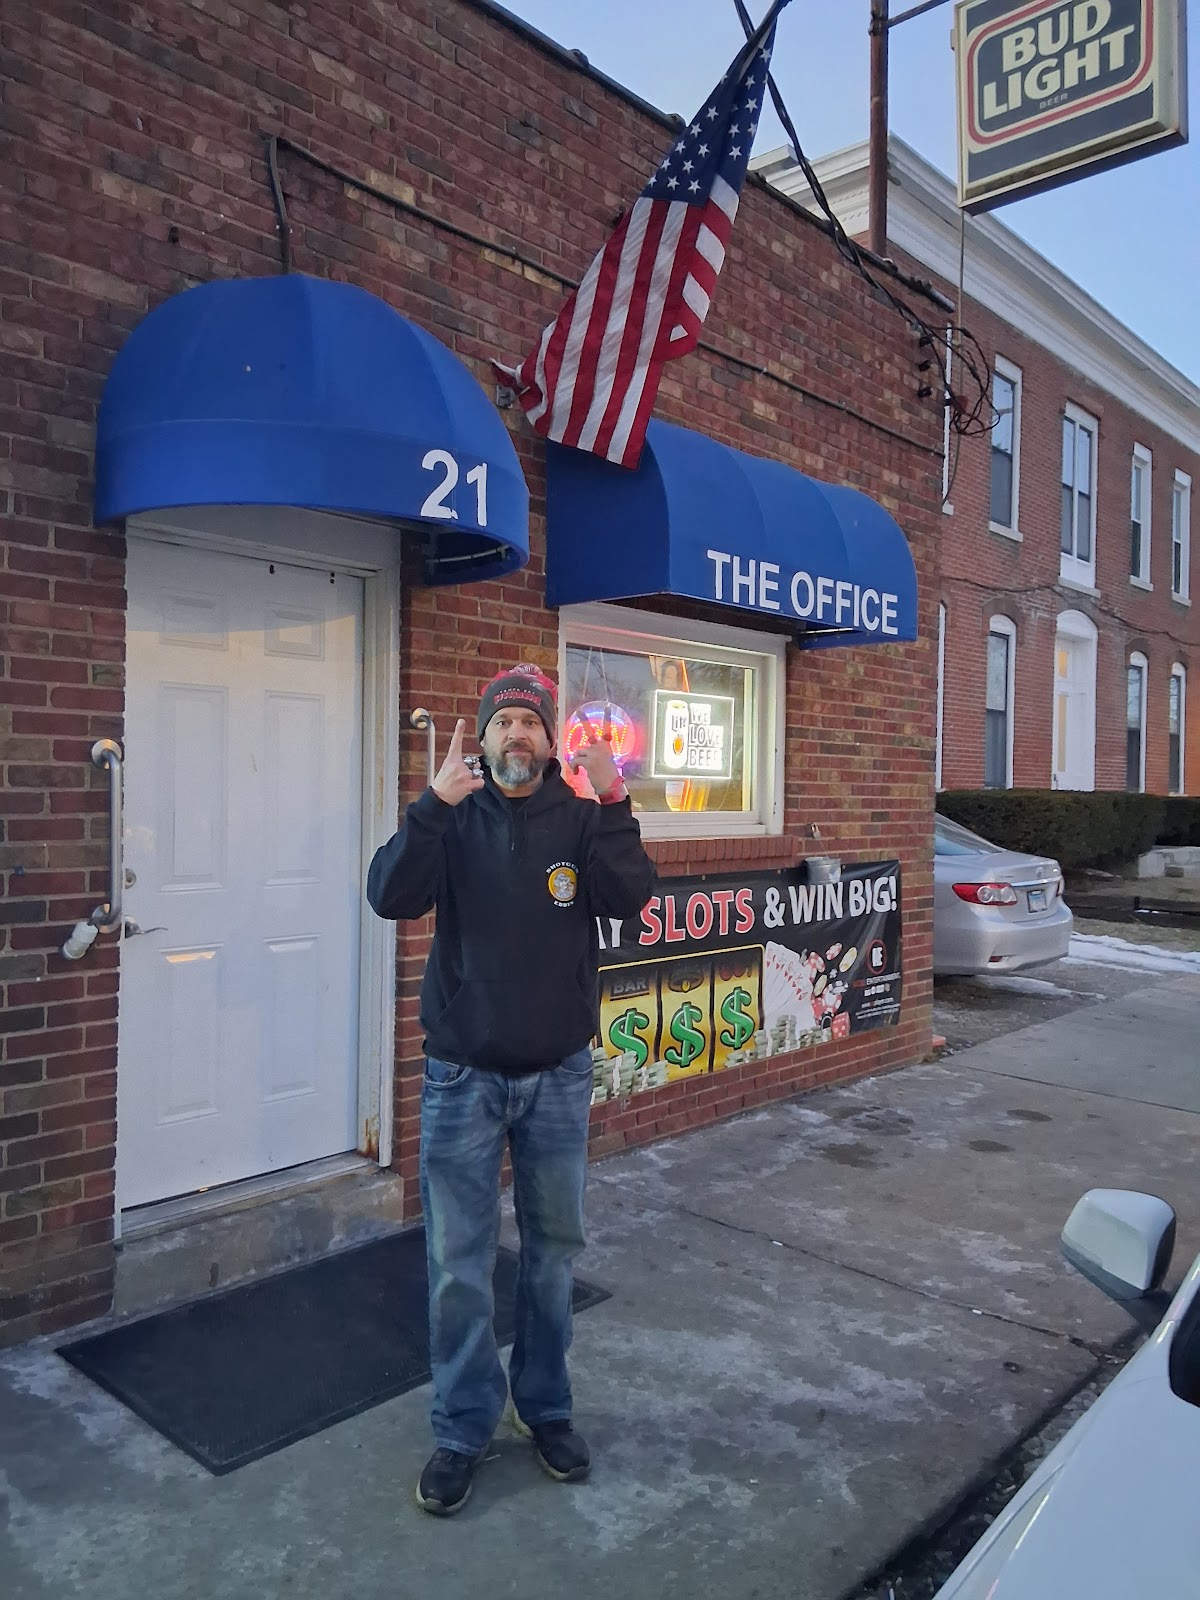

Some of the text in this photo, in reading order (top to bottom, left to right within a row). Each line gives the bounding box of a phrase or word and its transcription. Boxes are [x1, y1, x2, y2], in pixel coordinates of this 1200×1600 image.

[983, 24, 1135, 120] LIGHT
[1002, 0, 1111, 72] BUD
[1039, 93, 1068, 110] BEER
[421, 449, 487, 527] 21
[707, 549, 898, 635] THE OFFICE
[638, 888, 755, 946] SLOTS
[764, 887, 785, 928] &
[788, 881, 843, 924] WIN
[849, 876, 897, 918] BIG!
[613, 977, 647, 994] BAR
